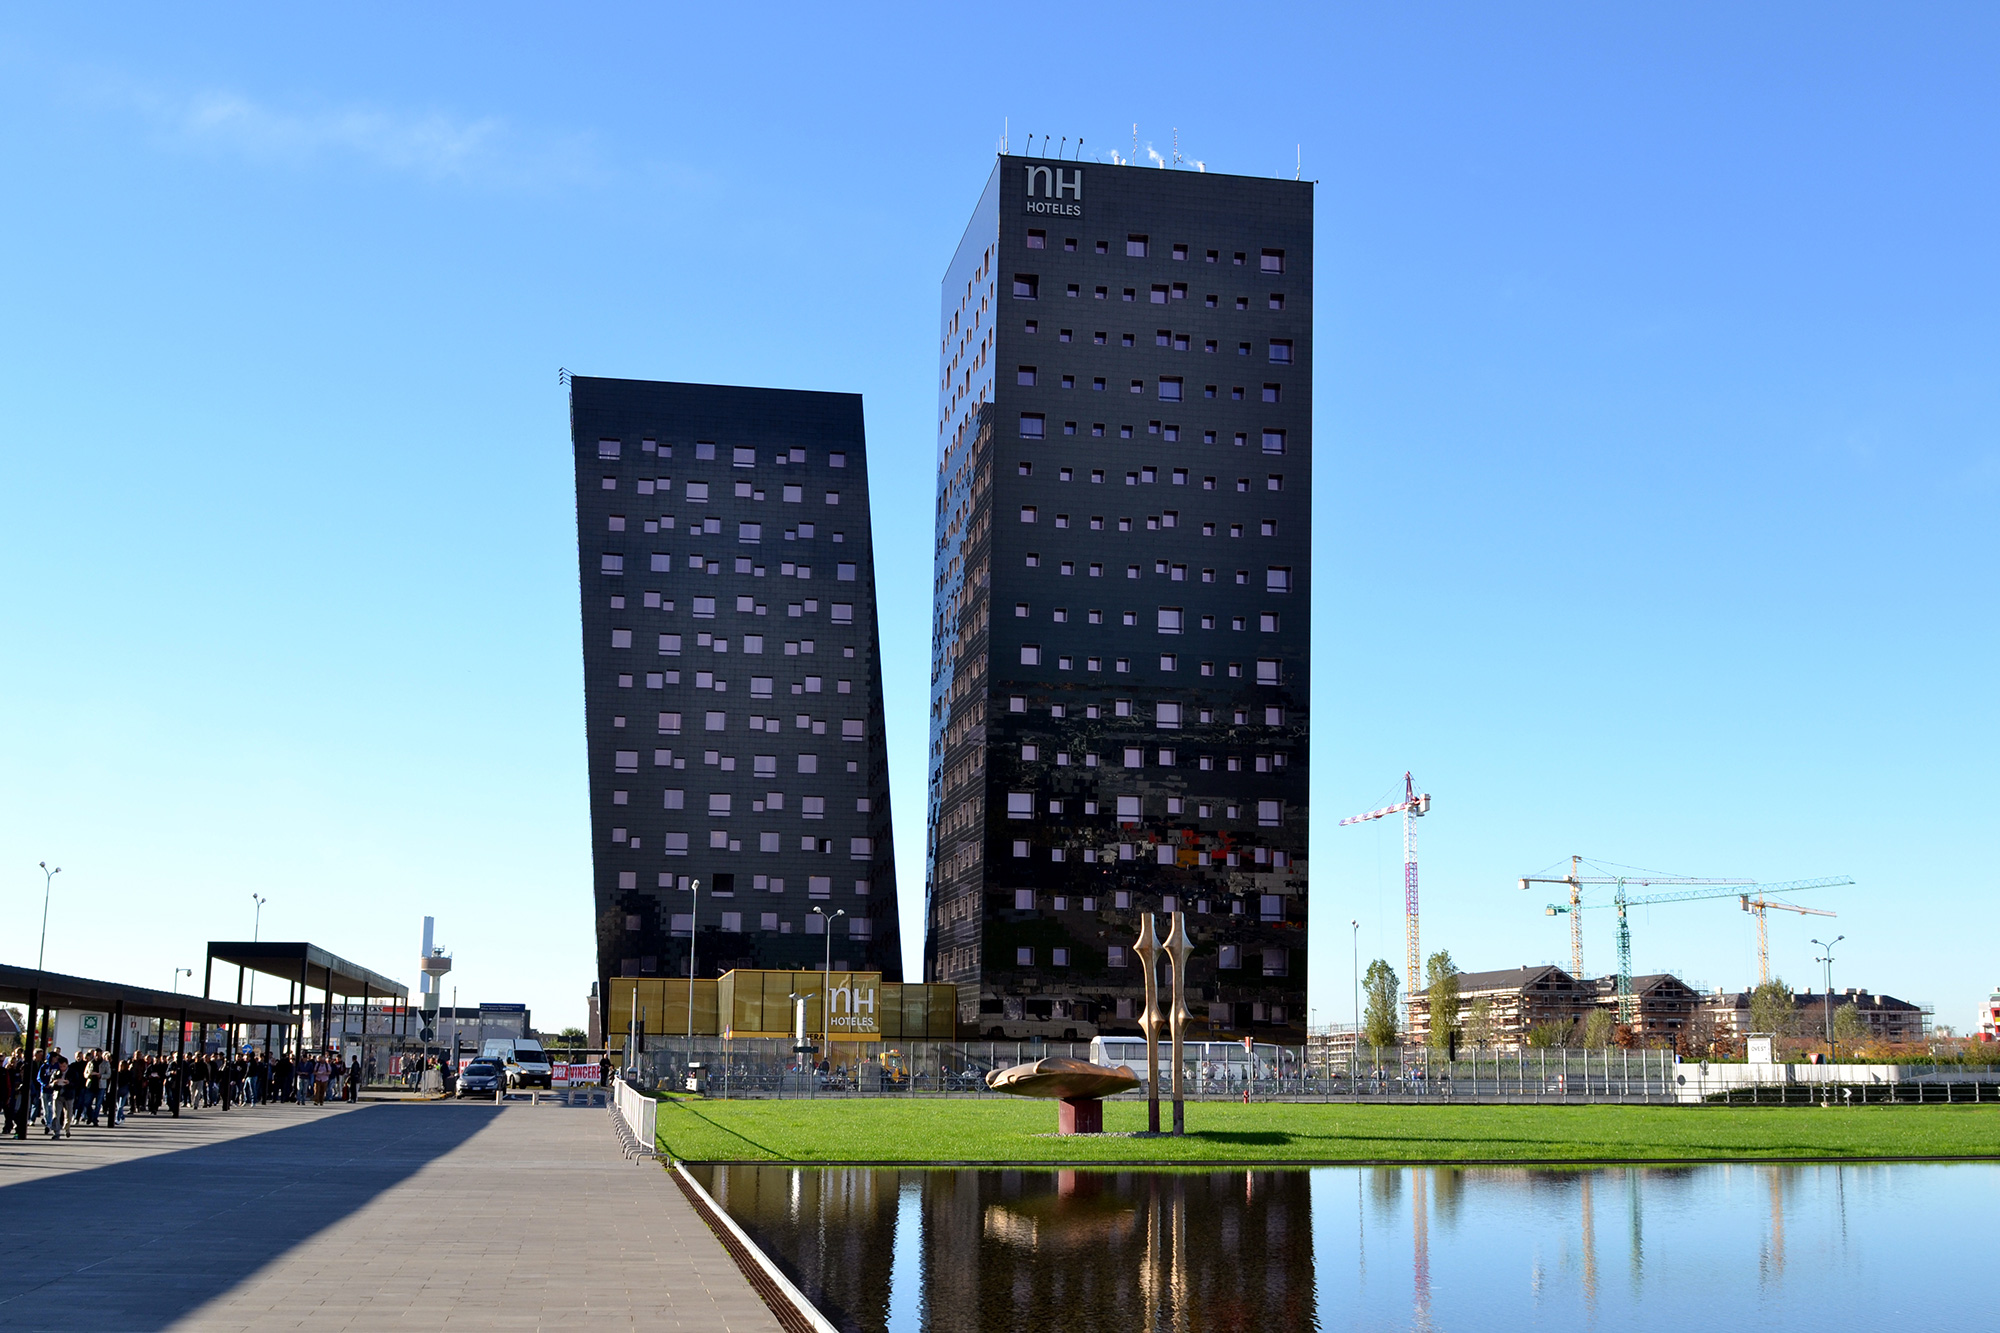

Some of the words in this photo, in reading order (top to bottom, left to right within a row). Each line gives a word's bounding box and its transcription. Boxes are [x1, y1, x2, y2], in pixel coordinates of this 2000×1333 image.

[1027, 201, 1081, 216] HOTELES
[831, 1017, 874, 1026] HOTELES
[570, 1065, 600, 1079] VINCERE
